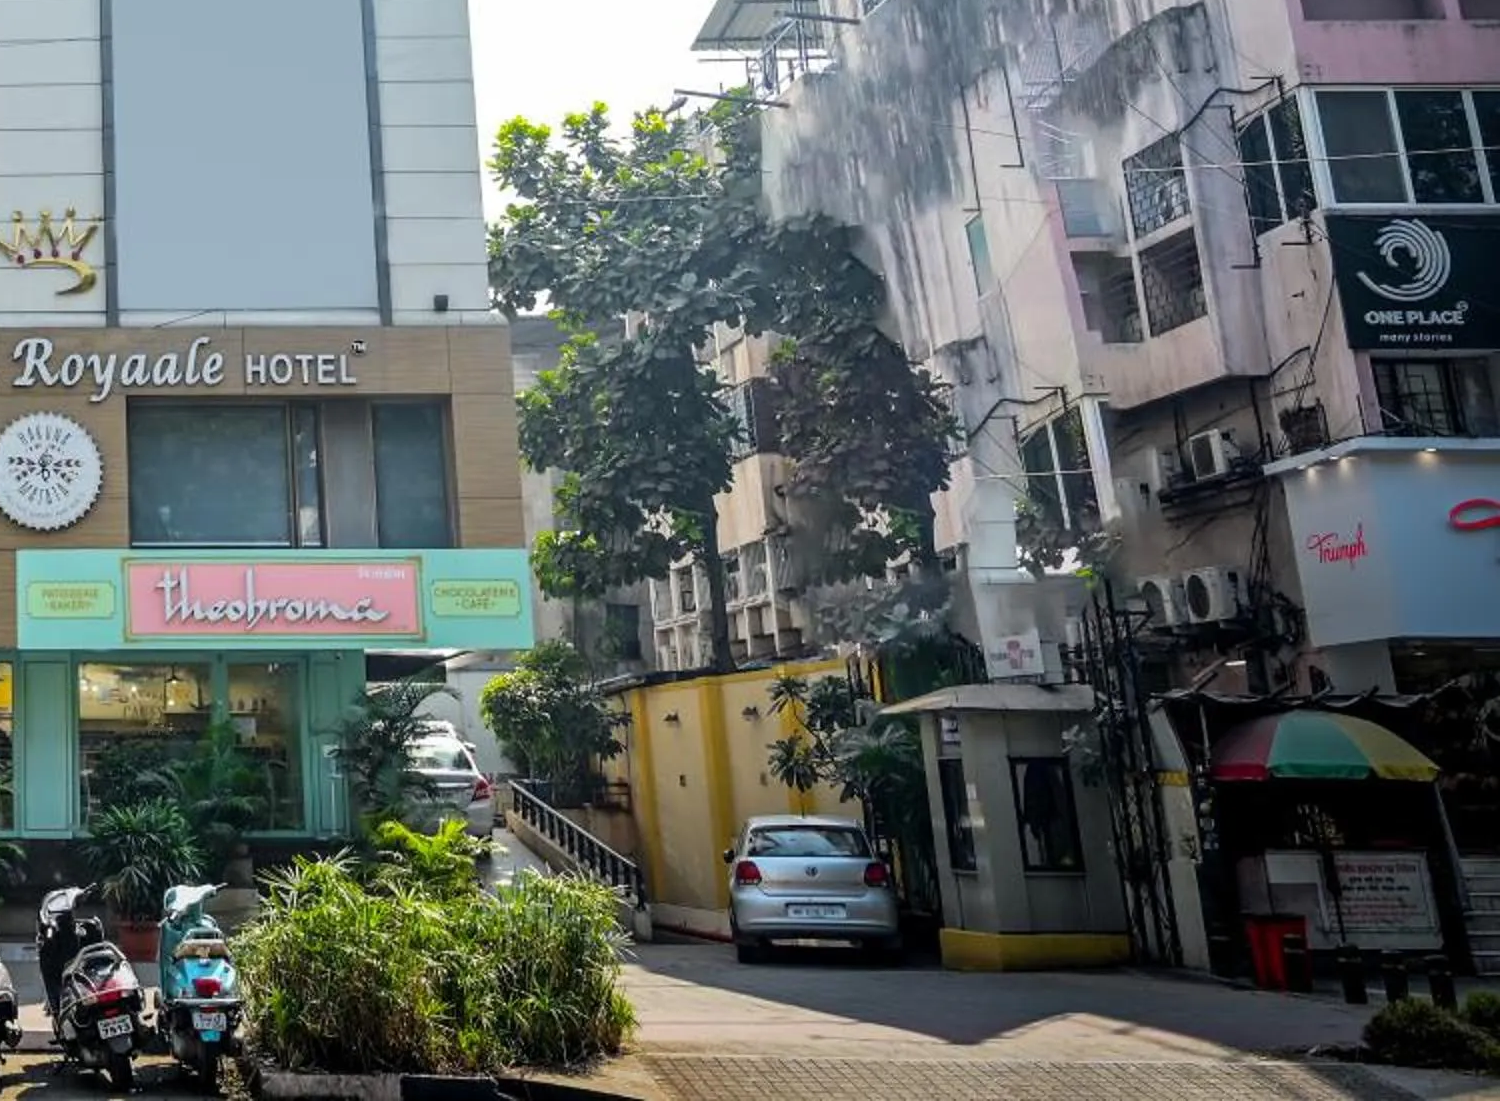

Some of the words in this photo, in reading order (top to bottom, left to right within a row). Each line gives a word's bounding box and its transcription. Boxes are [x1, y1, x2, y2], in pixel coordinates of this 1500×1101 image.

[1364, 310, 1404, 325] ONE
[1405, 310, 1465, 325] PLACE
[12, 336, 224, 402] Royaale
[246, 354, 357, 384] HOTEL
[1308, 521, 1367, 570] Triumph
[156, 568, 389, 632] theobroma
